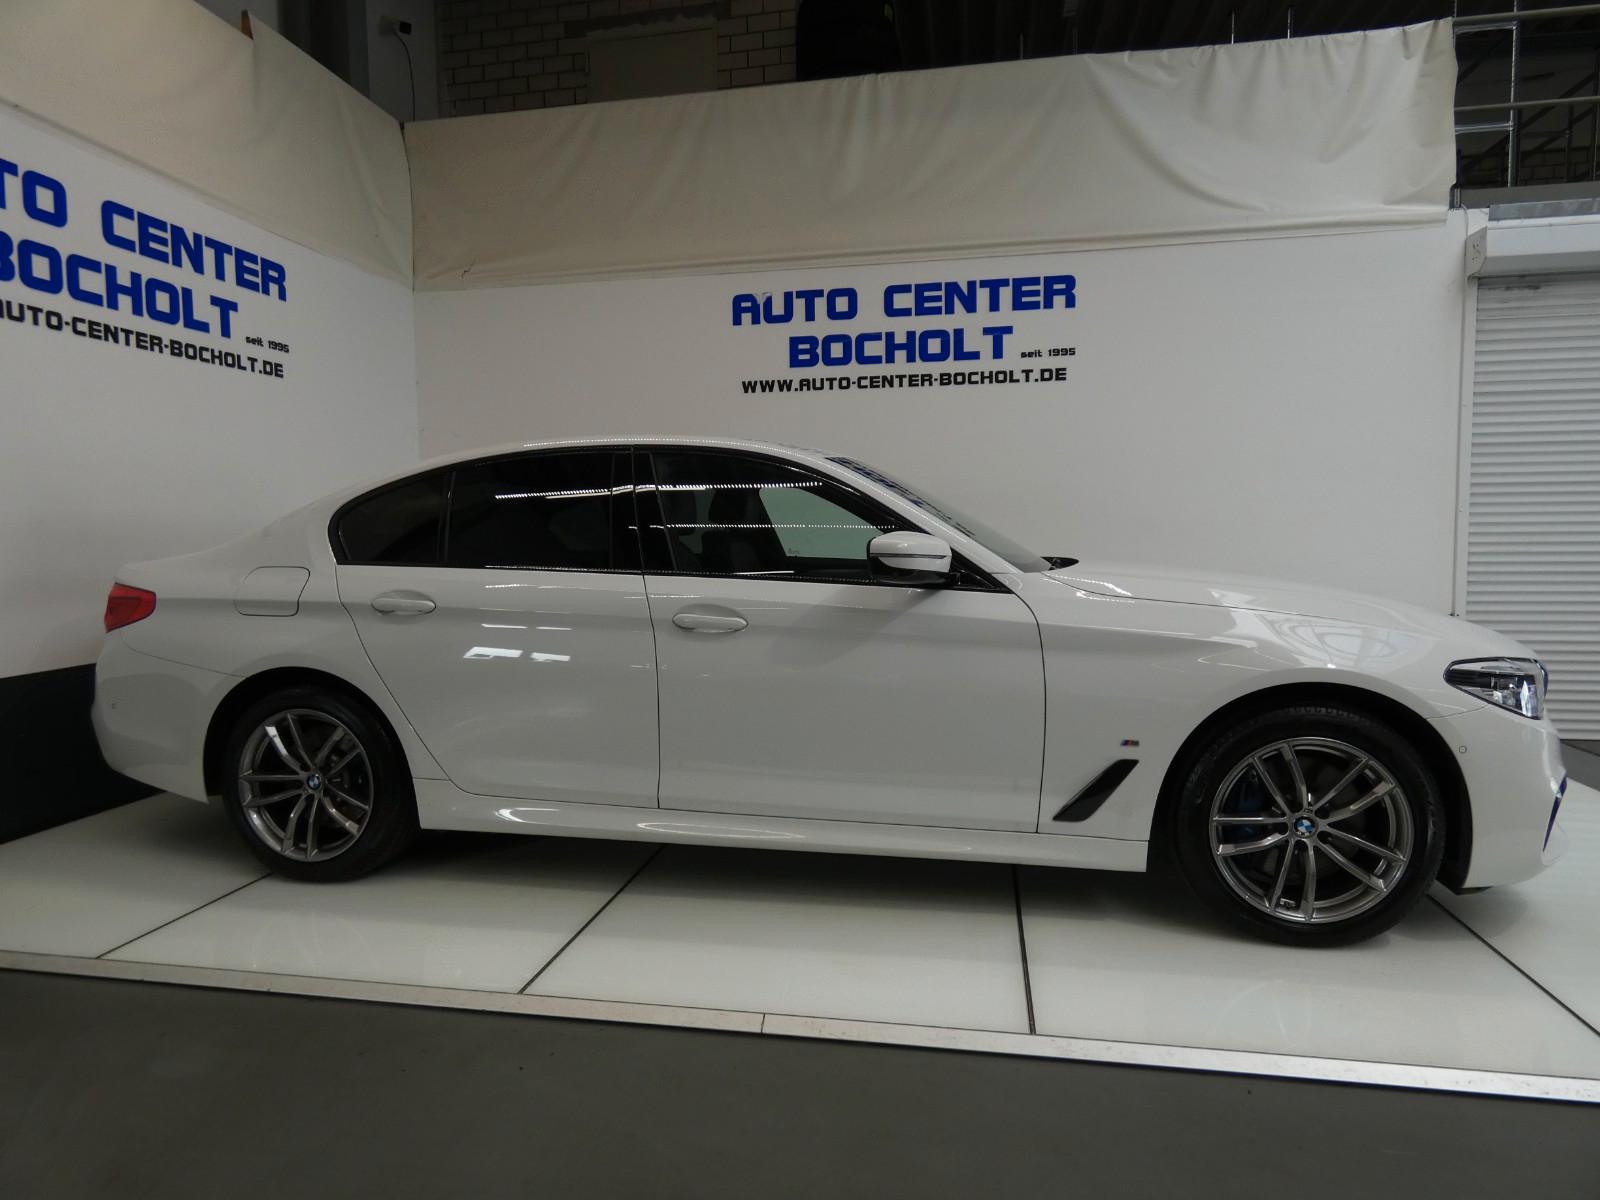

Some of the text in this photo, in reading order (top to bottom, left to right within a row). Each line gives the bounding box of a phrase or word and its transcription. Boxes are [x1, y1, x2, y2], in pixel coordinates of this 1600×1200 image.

[101, 200, 287, 303] CENTER
[732, 274, 1077, 327] AUTO CENTER
[0, 298, 284, 379] UTO-CENTER-BOCHOLT.DE
[245, 336, 290, 354] seit 1995
[789, 325, 1014, 369] BOCHOLT
[1020, 347, 1076, 359] seit 1995
[741, 367, 1067, 394] WWW.AUTO-CENTER-BOCHOLT.DE
